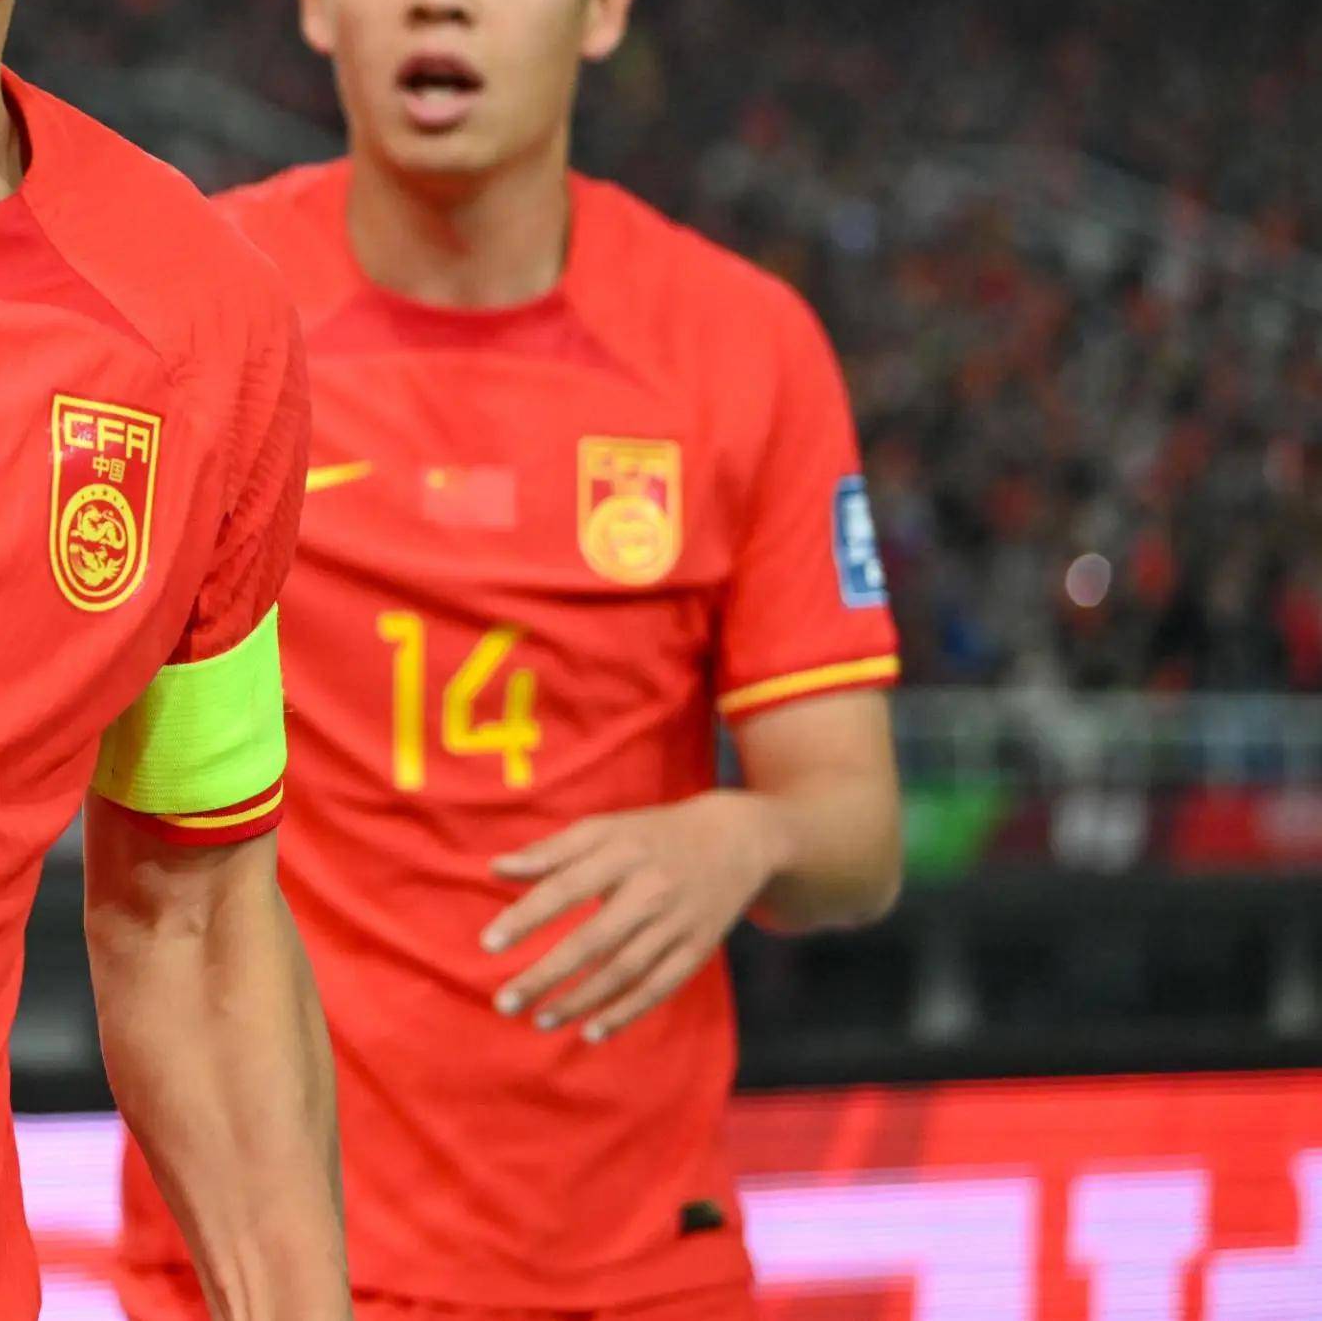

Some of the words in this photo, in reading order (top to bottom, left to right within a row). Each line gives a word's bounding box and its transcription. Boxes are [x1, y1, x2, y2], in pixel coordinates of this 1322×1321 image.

[63, 411, 150, 464] CFA
[92, 453, 126, 484] 中国
[376, 610, 541, 793] 14
